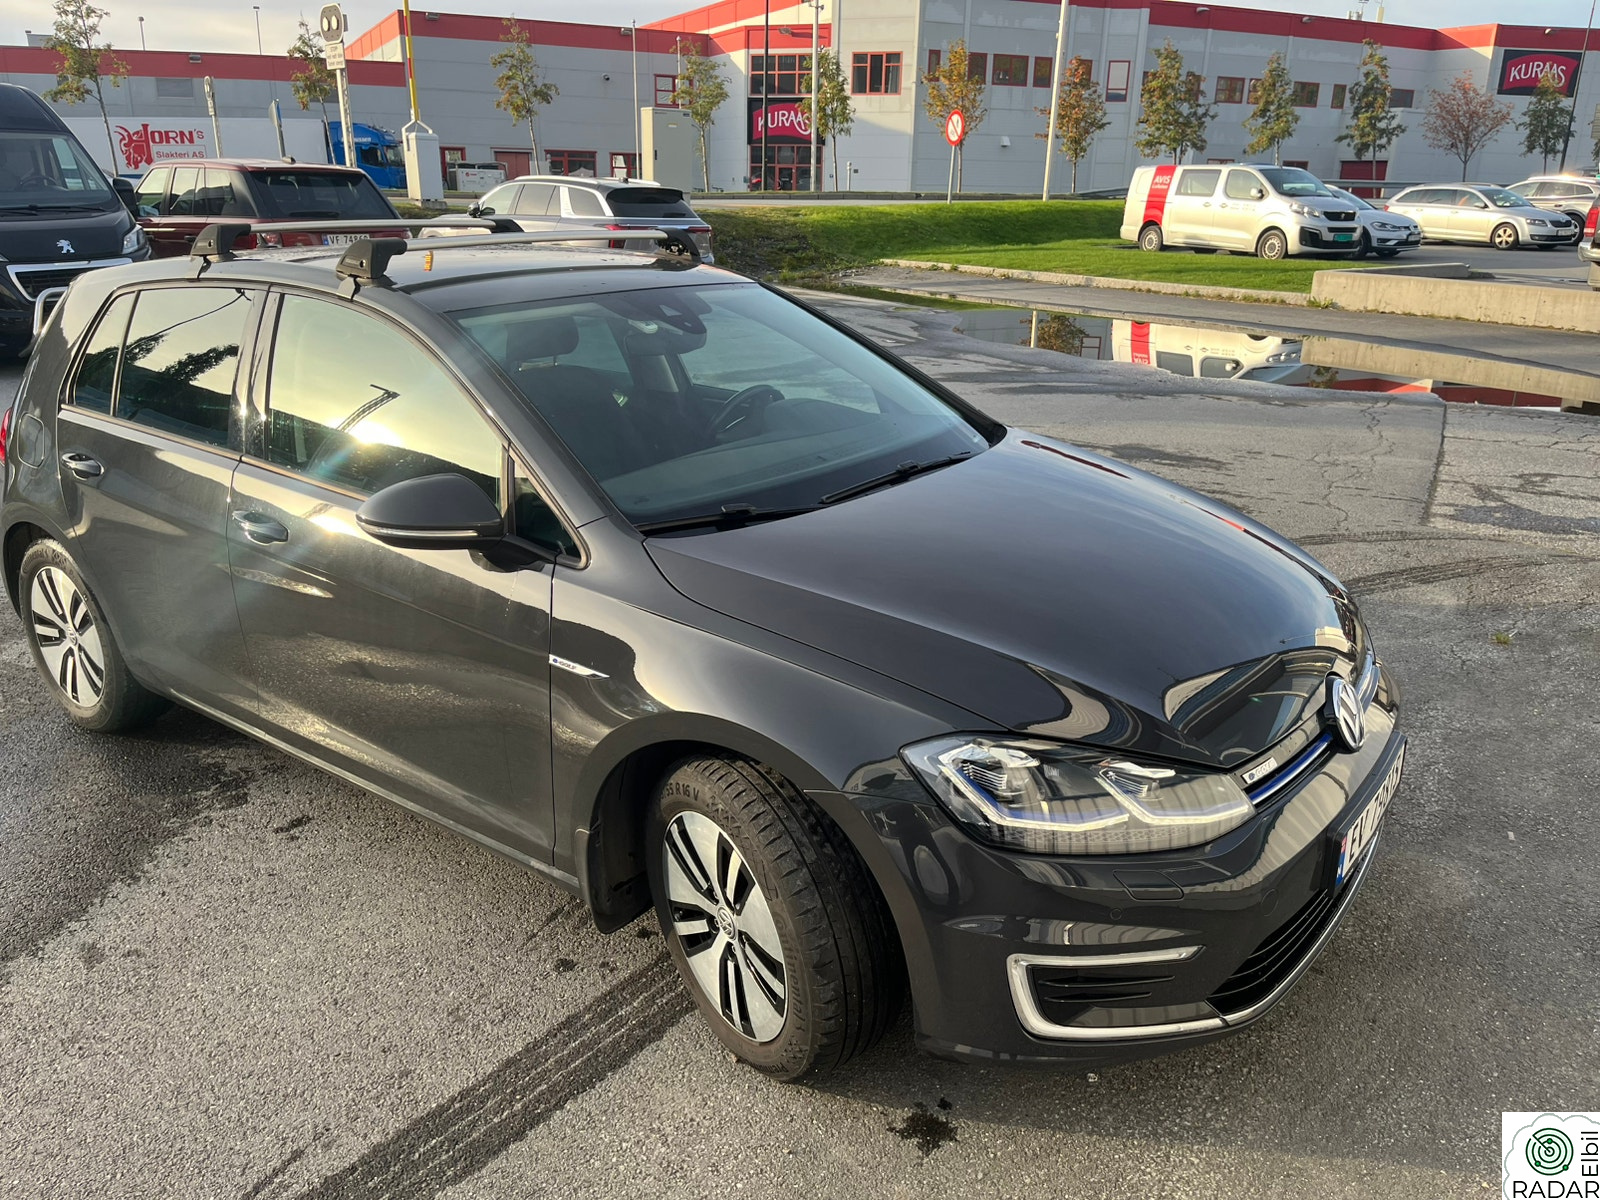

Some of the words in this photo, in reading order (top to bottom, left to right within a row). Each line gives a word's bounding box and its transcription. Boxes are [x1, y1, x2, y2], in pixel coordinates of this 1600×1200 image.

[1509, 61, 1567, 88] KURAAS
[155, 150, 189, 159] Slakteri
[191, 151, 205, 159] AS
[1153, 175, 1171, 184] AVIS
[329, 235, 339, 245] VF
